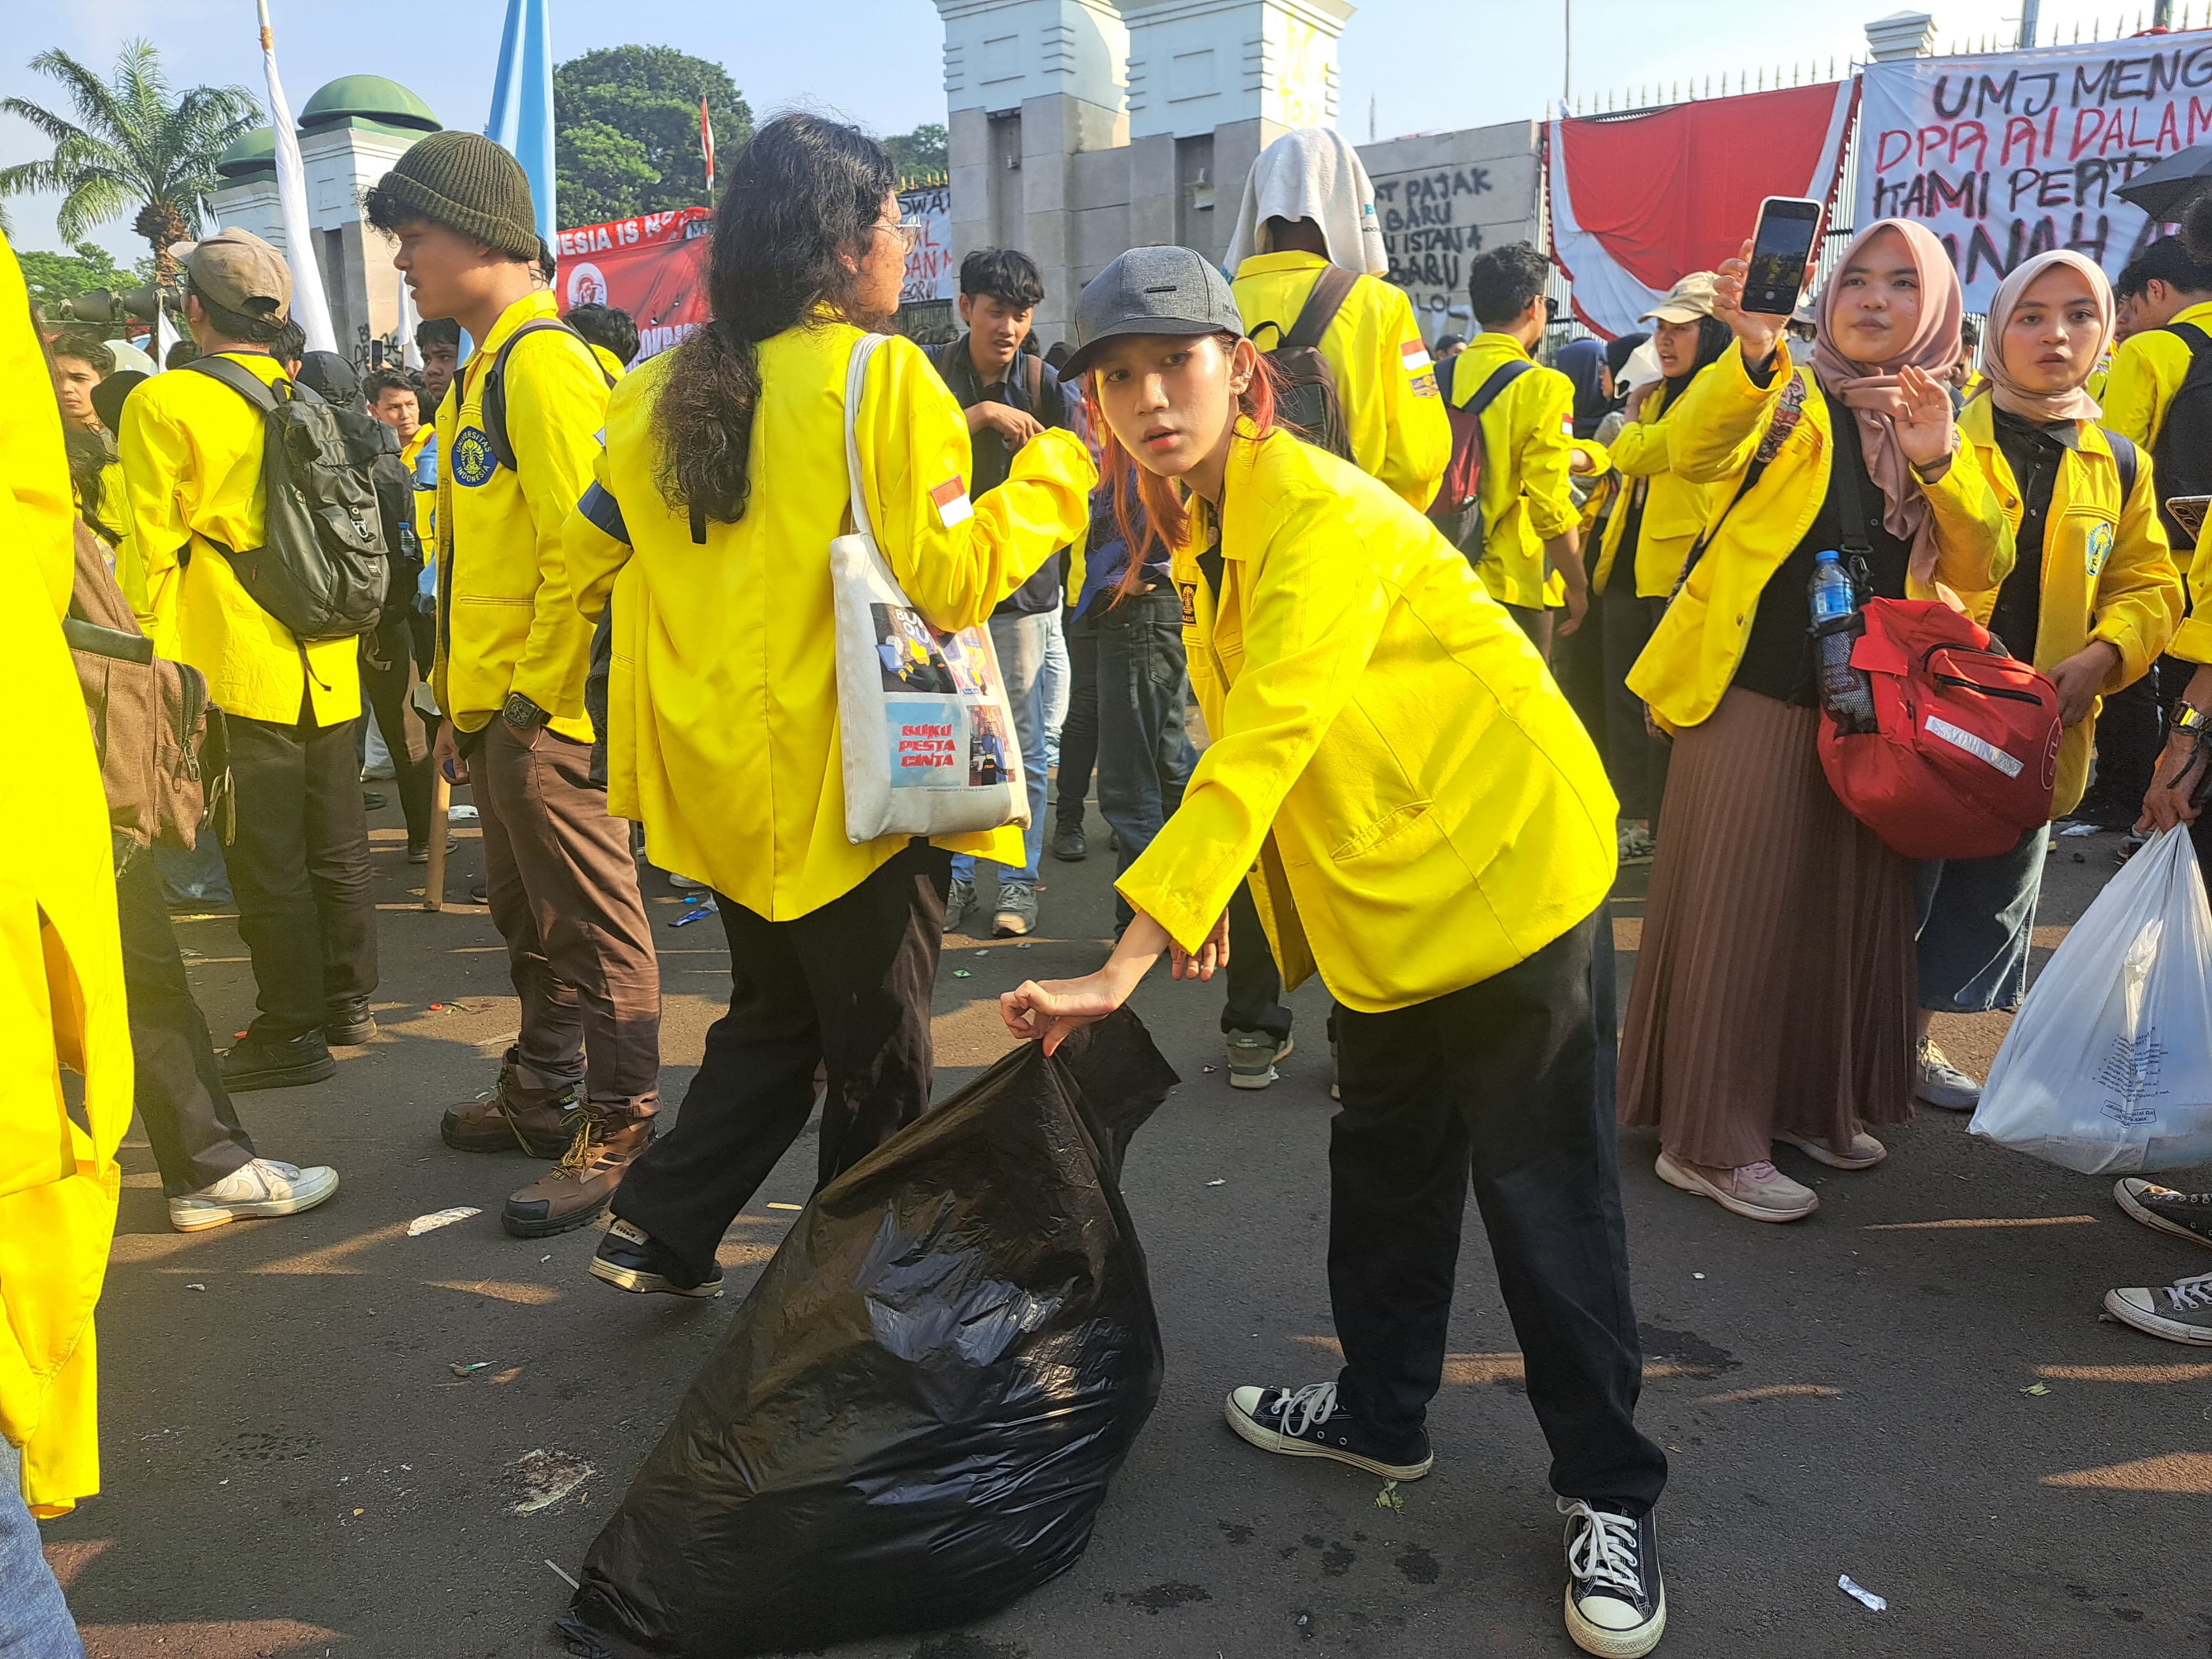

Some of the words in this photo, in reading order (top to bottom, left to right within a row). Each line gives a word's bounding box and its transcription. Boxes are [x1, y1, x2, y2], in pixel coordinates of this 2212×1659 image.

[1933, 70, 2059, 121] UMJ
[1405, 168, 1493, 206] PAJAK
[1873, 169, 1990, 220] KAMI
[1386, 200, 1452, 232] BARU
[616, 220, 640, 246] IS
[1387, 252, 1460, 290] BARU
[456, 431, 492, 454] UNIVERSITAS
[456, 464, 491, 483] INDONESIA
[902, 723, 952, 740] BUKU
[898, 738, 957, 753] PESTA
[900, 752, 955, 767] CINTA
